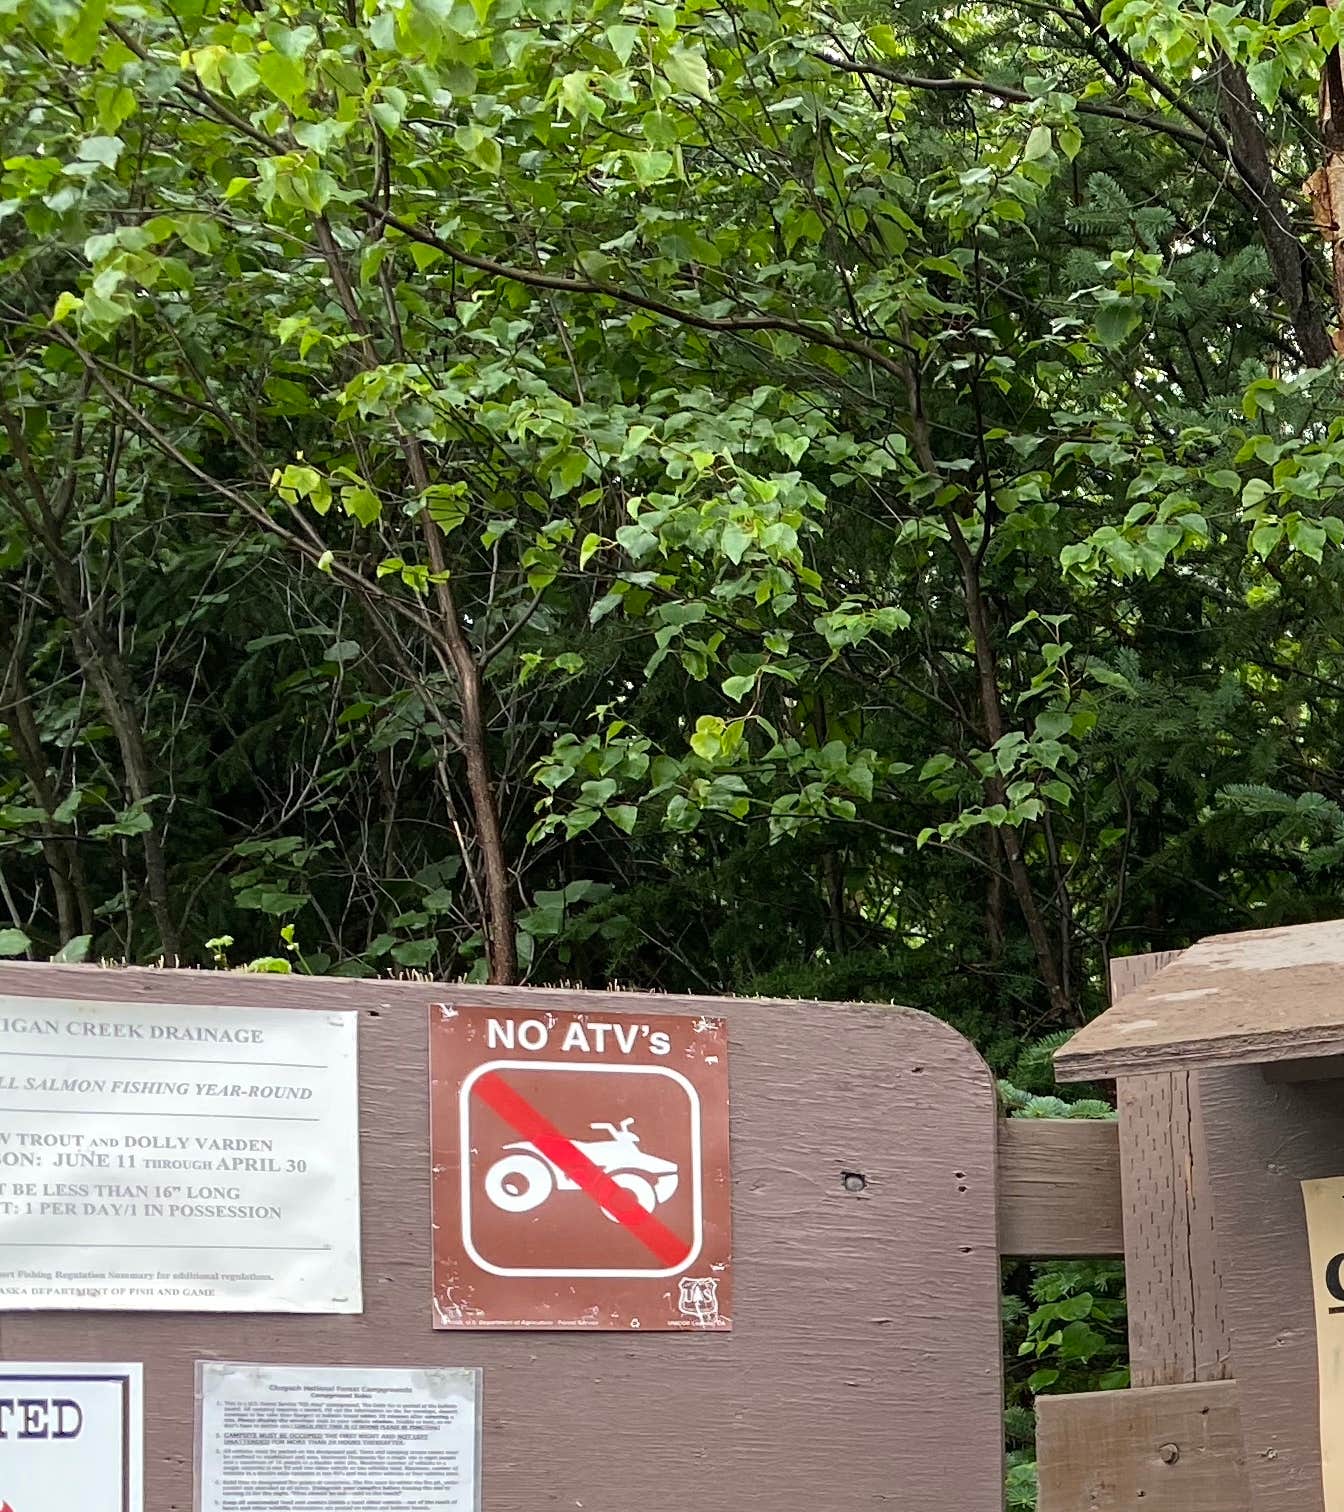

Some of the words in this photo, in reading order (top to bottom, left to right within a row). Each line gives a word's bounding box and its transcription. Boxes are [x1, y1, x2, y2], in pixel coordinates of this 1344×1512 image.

[66, 1020, 144, 1039] CREEK
[151, 1025, 264, 1044] DRAINAGE
[487, 1018, 549, 1050] NO
[561, 1021, 671, 1056] ATV's
[24, 1077, 106, 1093] SALMON
[111, 1080, 189, 1096] FISHING
[196, 1083, 313, 1100] YEAR-ROUND
[17, 1133, 84, 1147] TROUT
[90, 1137, 119, 1148] AND
[124, 1136, 189, 1150] DOLLY
[197, 1138, 273, 1151] VARDEN
[54, 1154, 110, 1168] JUNE
[118, 1154, 136, 1168] 11
[143, 1158, 212, 1170] THROUGH
[216, 1158, 281, 1172] APRIL
[286, 1159, 306, 1172] 30
[12, 1184, 37, 1197] BE
[43, 1184, 89, 1197] LESS
[94, 1185, 148, 1198] THAN
[187, 1187, 240, 1200] LONG
[24, 1203, 33, 1215] 1
[40, 1203, 76, 1216] PER
[84, 1204, 137, 1217] DAY/1
[144, 1205, 164, 1217] IN
[169, 1205, 281, 1219] POSSESSION
